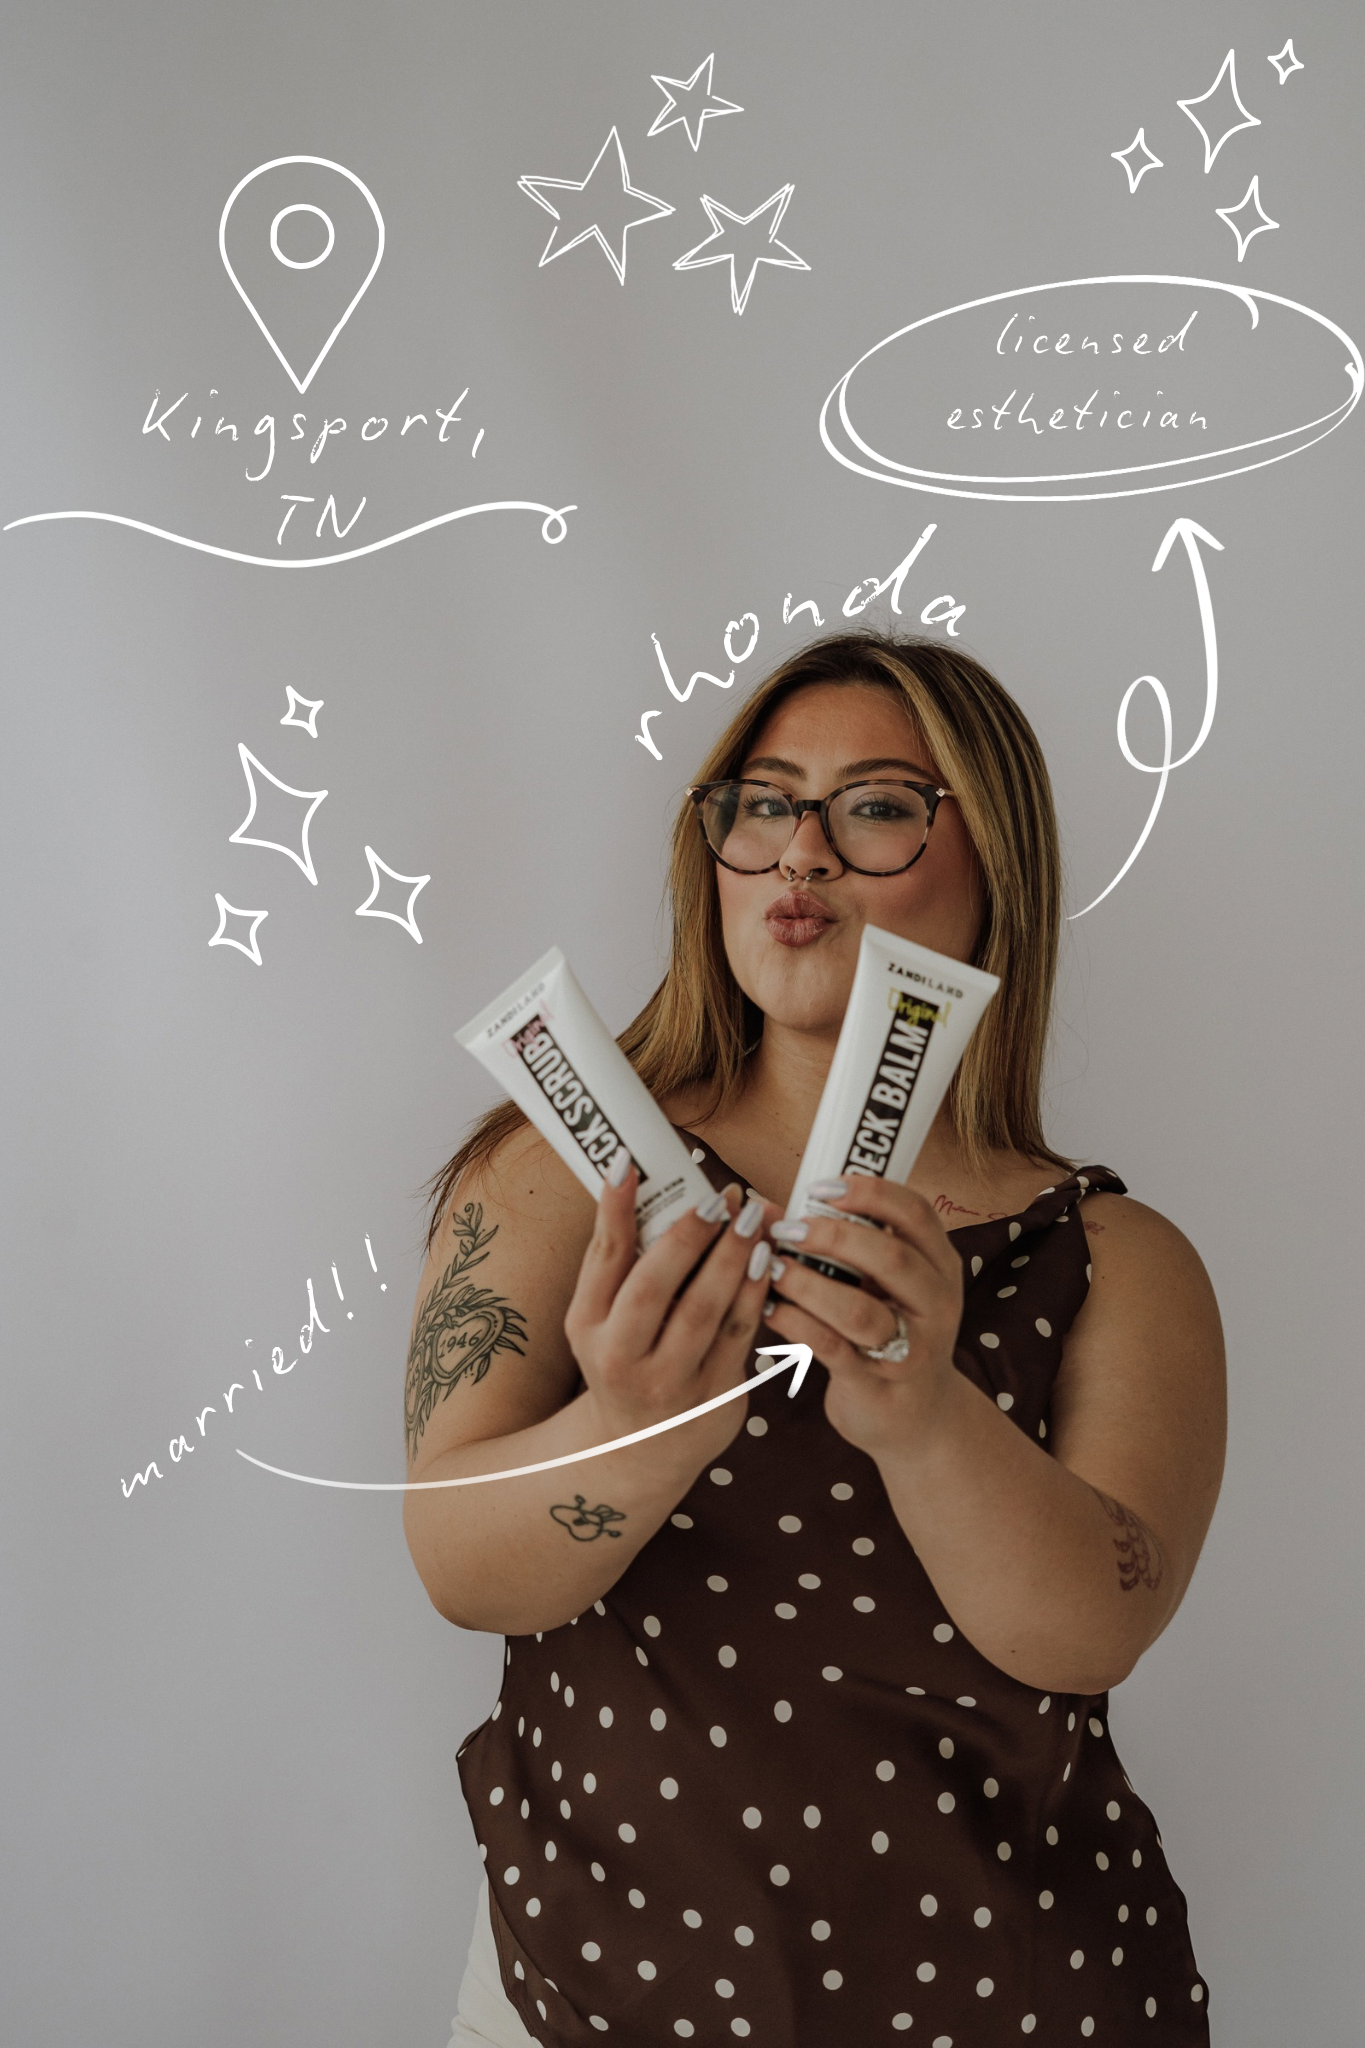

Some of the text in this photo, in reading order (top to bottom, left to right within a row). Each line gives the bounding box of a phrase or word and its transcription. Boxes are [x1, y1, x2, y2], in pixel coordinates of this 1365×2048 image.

[524, 1032, 592, 1126] SCRUB
[872, 1016, 928, 1108] BALM
[438, 1330, 482, 1358] 1946
